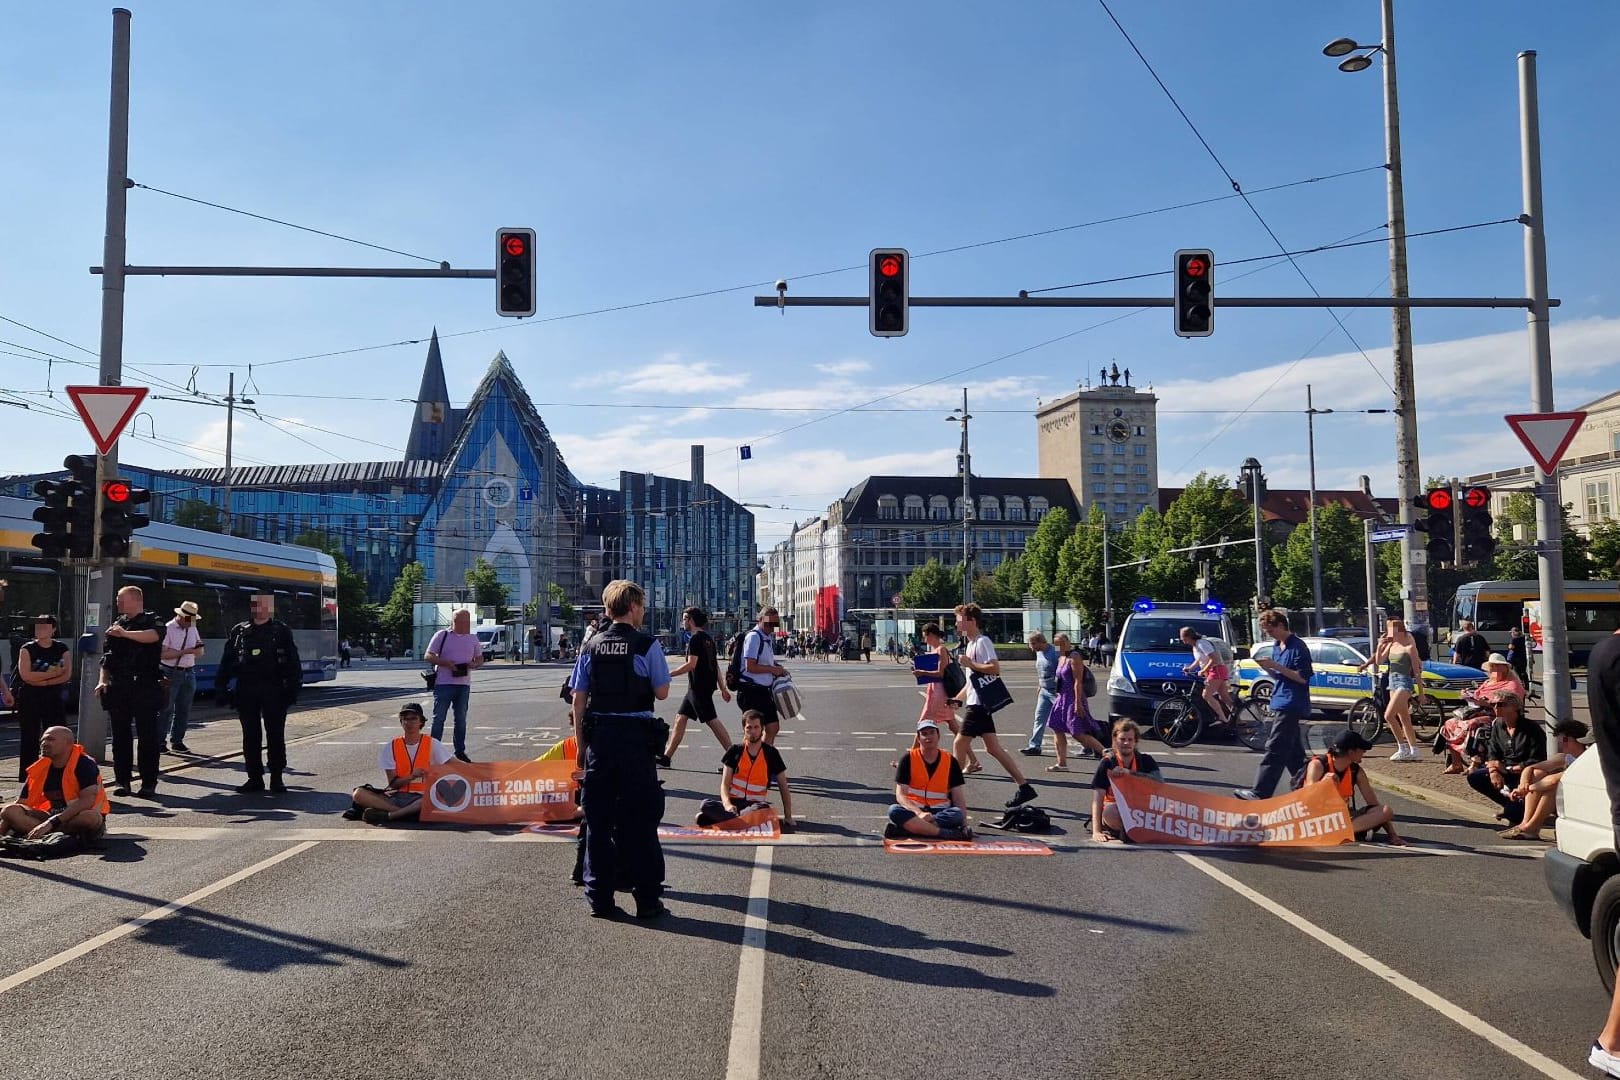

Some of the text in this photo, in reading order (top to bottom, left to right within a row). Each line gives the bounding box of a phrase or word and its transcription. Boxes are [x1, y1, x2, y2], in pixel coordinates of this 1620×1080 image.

[522, 489, 530, 499] T
[595, 642, 628, 655] POLIZEI
[1326, 675, 1361, 686] POLIZEI
[474, 781, 502, 795] ART.
[535, 779, 555, 792] GG
[474, 791, 569, 807] LEBEN SCHÜTZEN
[1149, 794, 1199, 820] MEHR
[1299, 811, 1346, 839] JETZT!
